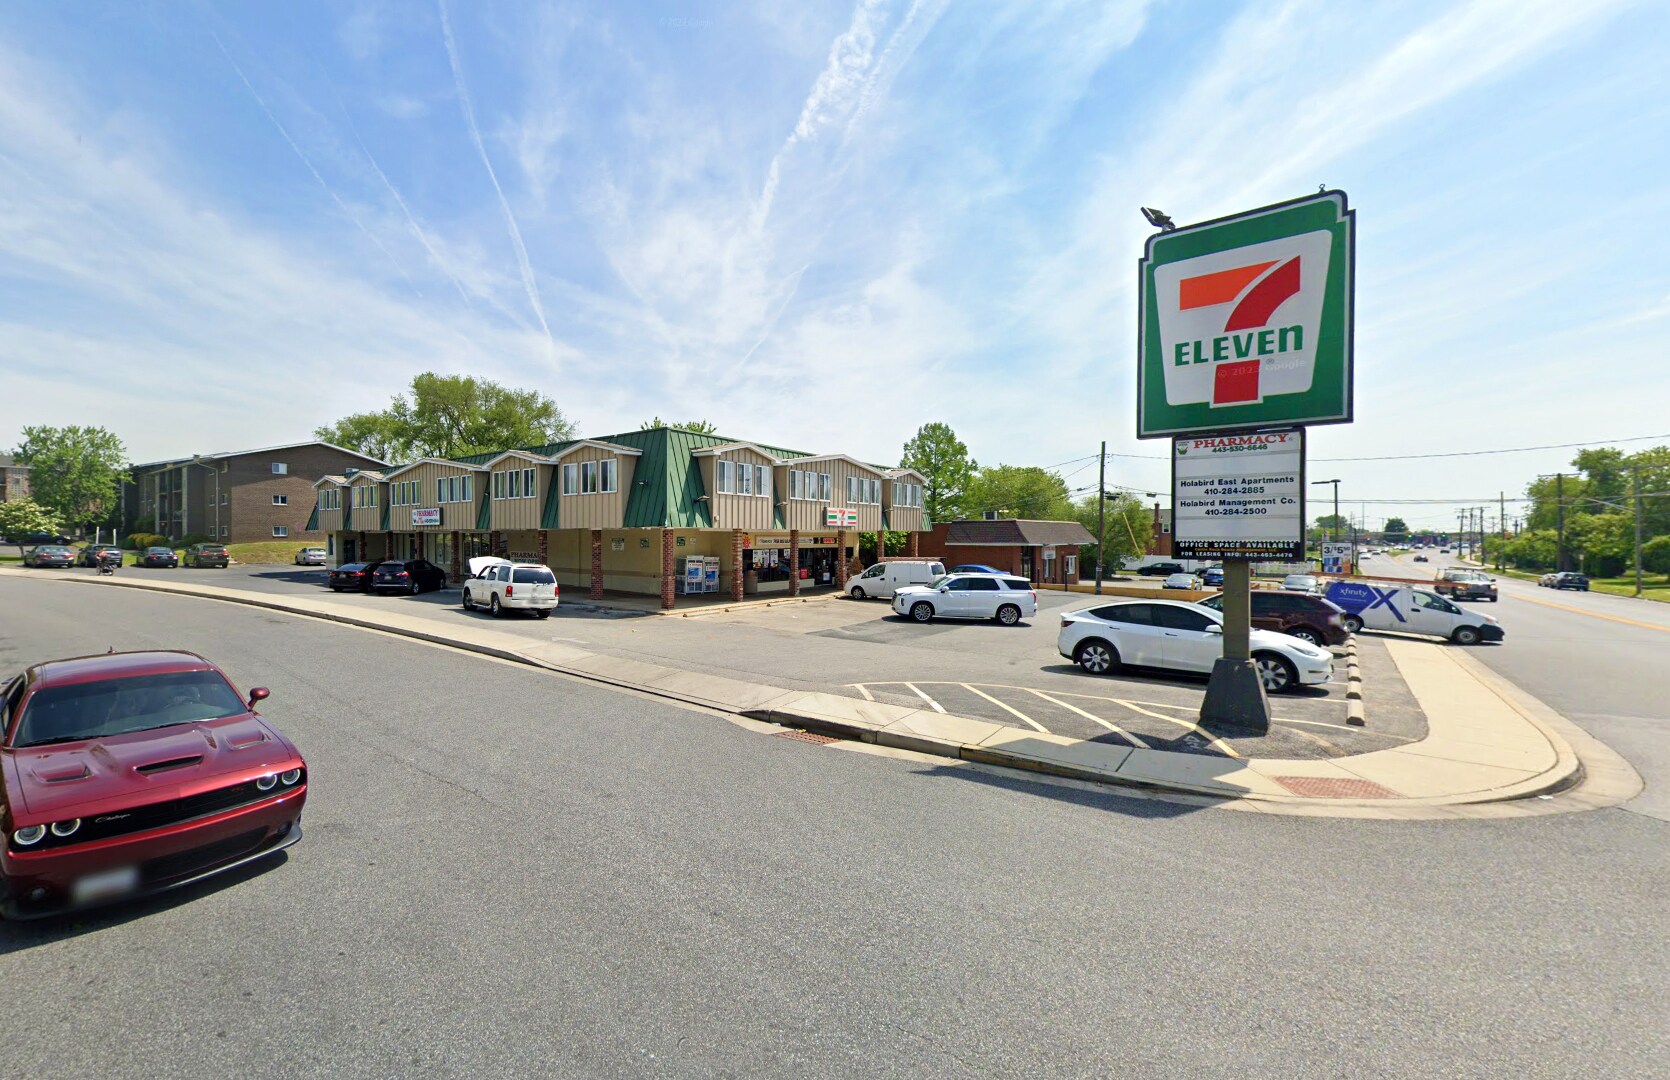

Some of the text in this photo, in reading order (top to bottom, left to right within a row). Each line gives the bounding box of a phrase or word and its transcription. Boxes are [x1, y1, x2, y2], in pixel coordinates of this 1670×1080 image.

[1180, 255, 1300, 404] 7
[1194, 434, 1289, 448] PHARMACY
[1180, 479, 1214, 487] Holabird
[1241, 476, 1295, 486] Apartments
[1204, 486, 1265, 495] 410-284-2885
[1180, 499, 1215, 507] Holabird
[1218, 498, 1276, 507] Management
[1205, 507, 1267, 515] 410-284-2500
[1340, 588, 1367, 598] xfinity
